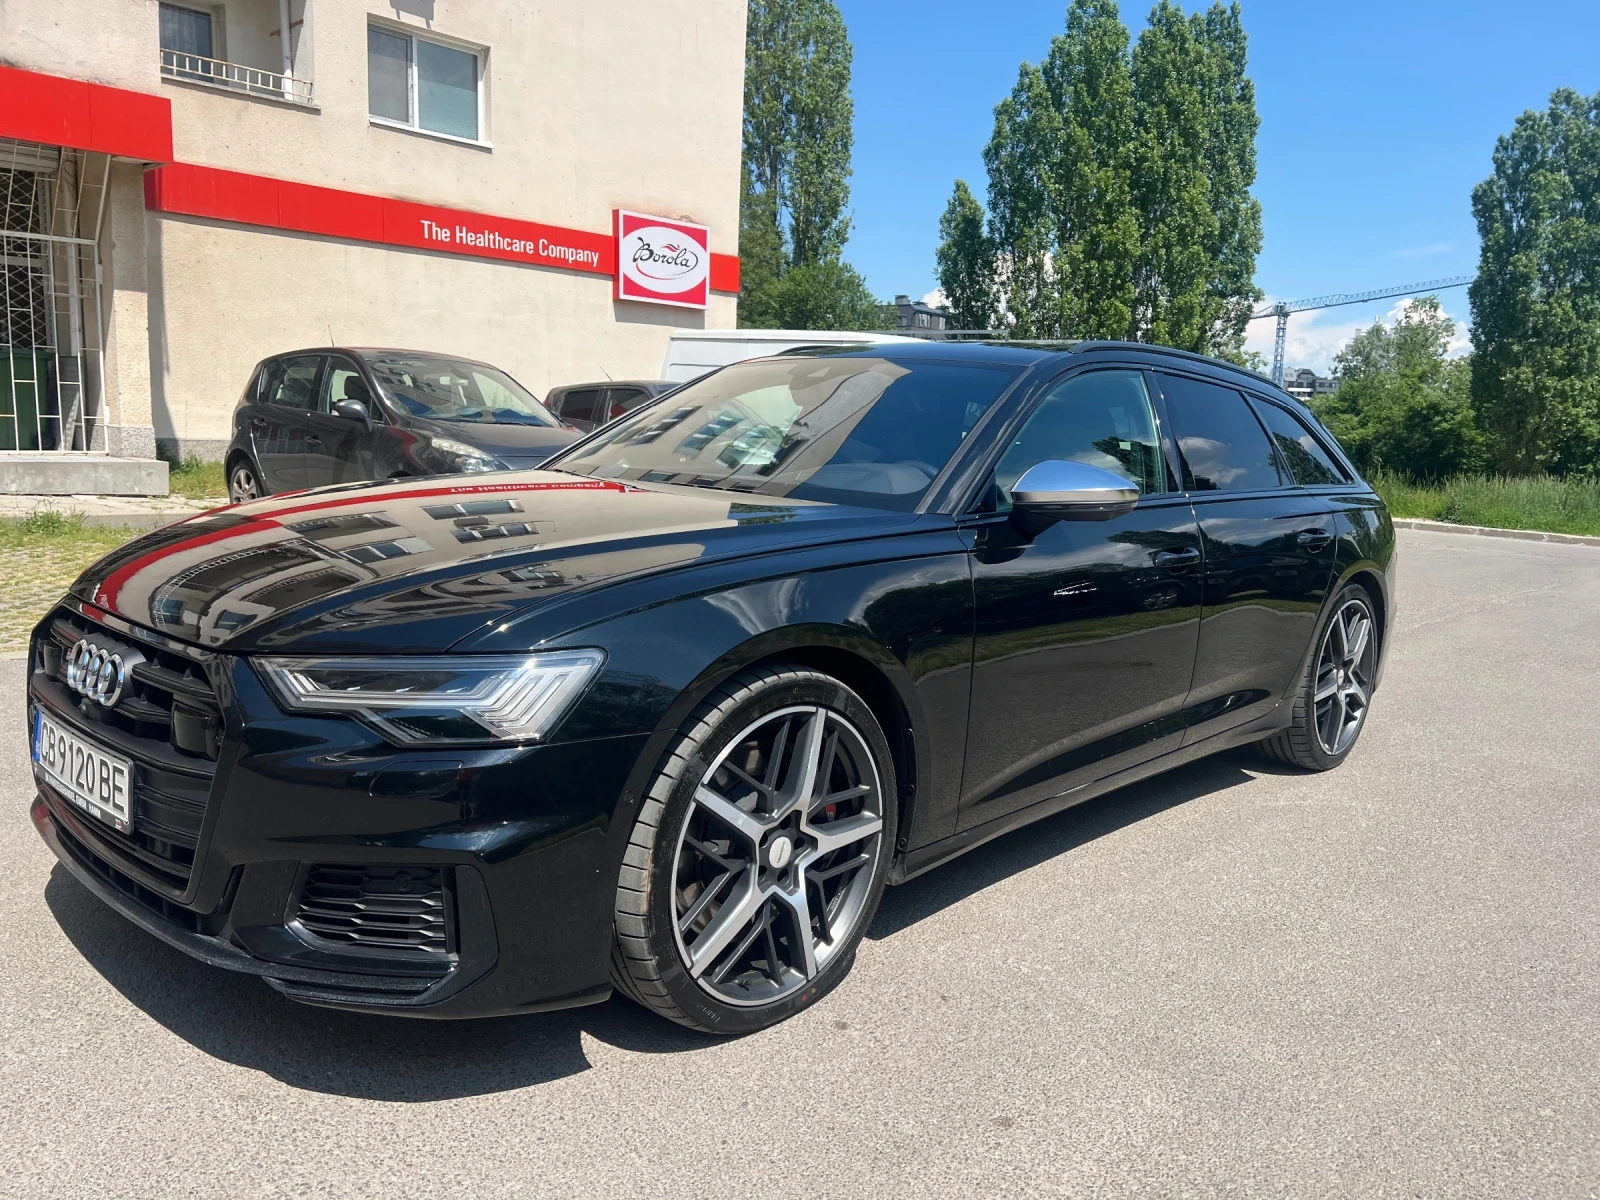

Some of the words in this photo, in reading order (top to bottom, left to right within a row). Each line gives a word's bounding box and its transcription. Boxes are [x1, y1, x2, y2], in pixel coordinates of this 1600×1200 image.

[420, 220, 451, 242] The
[455, 225, 534, 254] Healthcare
[538, 238, 599, 267] Company
[632, 236, 692, 268] Borola
